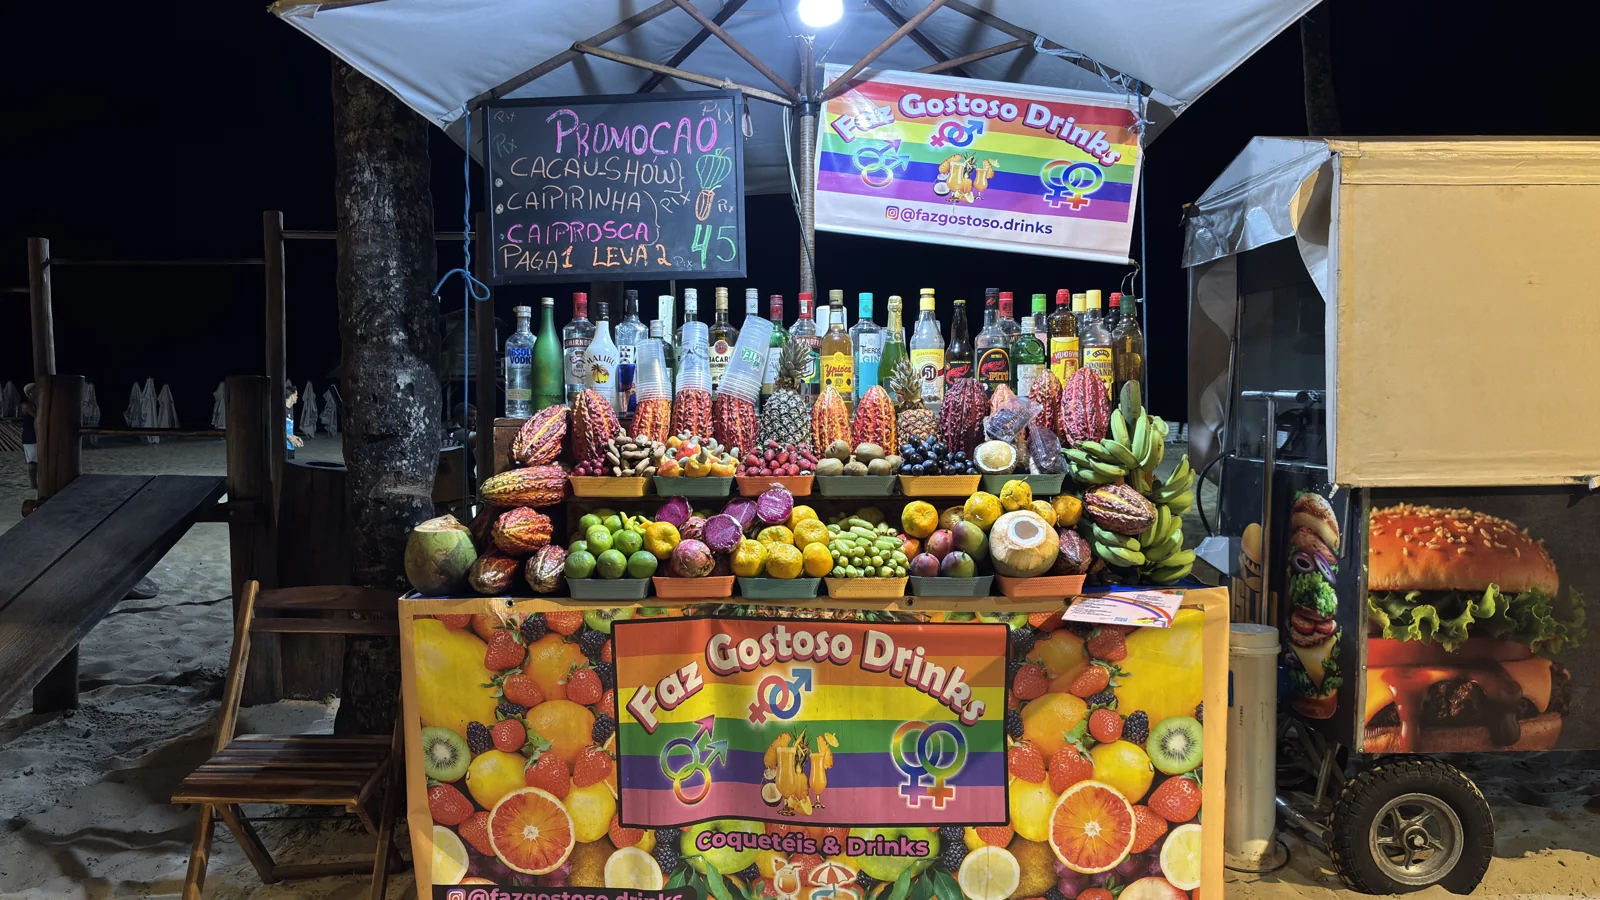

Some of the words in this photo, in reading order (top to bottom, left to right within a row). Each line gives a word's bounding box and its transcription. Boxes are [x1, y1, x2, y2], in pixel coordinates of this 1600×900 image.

[831, 105, 896, 144] Faz
[898, 93, 1018, 121] Gostoso
[1022, 103, 1122, 168] Drinks
[507, 185, 641, 214] CAIPIRINHA
[900, 207, 1053, 235] @fazgostoso.drinks
[499, 243, 558, 274] PAGA
[560, 245, 574, 269] 1
[592, 244, 649, 268] LEVA
[655, 243, 672, 267] 2
[691, 224, 737, 270] 45
[508, 348, 533, 357] ABSOL
[510, 356, 532, 365] VODK
[587, 354, 617, 367] MALIBU
[709, 355, 731, 363] BACAR
[863, 355, 881, 364] GIN
[924, 367, 936, 381] 51
[626, 661, 704, 735] Faz
[705, 624, 853, 675] Gostoso
[860, 629, 987, 727] Drinks
[695, 830, 817, 856] Coquetéis
[822, 836, 841, 854] &
[846, 835, 930, 858] Drinks
